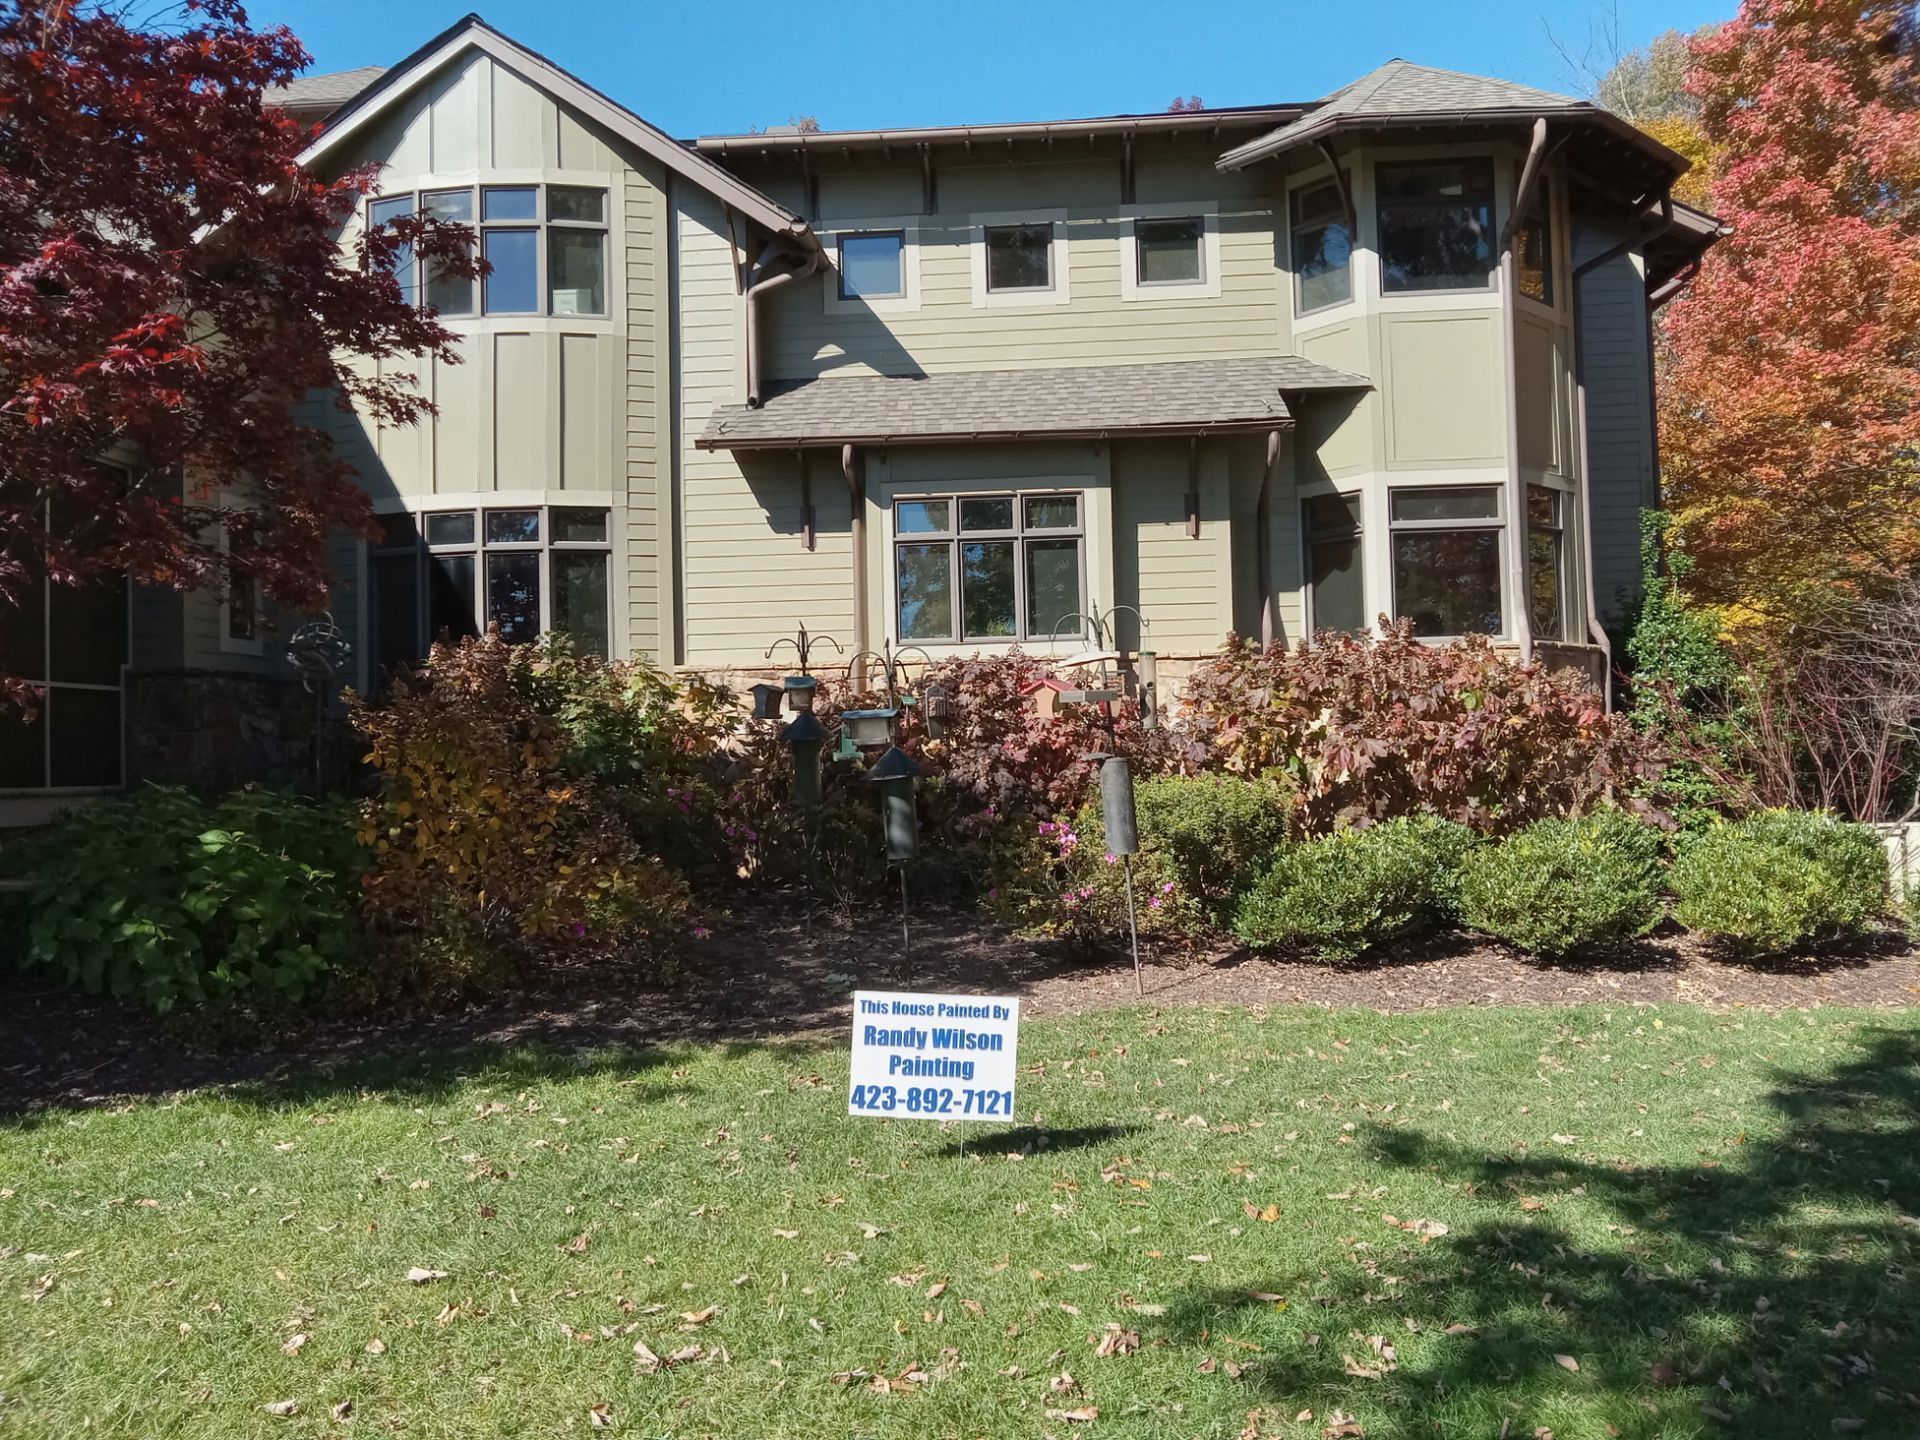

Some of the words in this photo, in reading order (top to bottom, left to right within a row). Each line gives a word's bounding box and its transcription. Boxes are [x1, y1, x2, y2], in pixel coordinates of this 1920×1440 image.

[860, 1000, 889, 1014] This
[892, 1001, 934, 1016] House
[938, 1003, 989, 1018] Painted
[993, 1005, 1009, 1020] By
[864, 1025, 927, 1050] Randy
[932, 1028, 1003, 1051] Wilson
[889, 1055, 974, 1080] Painting
[851, 1085, 1012, 1115] 423-892-7121
